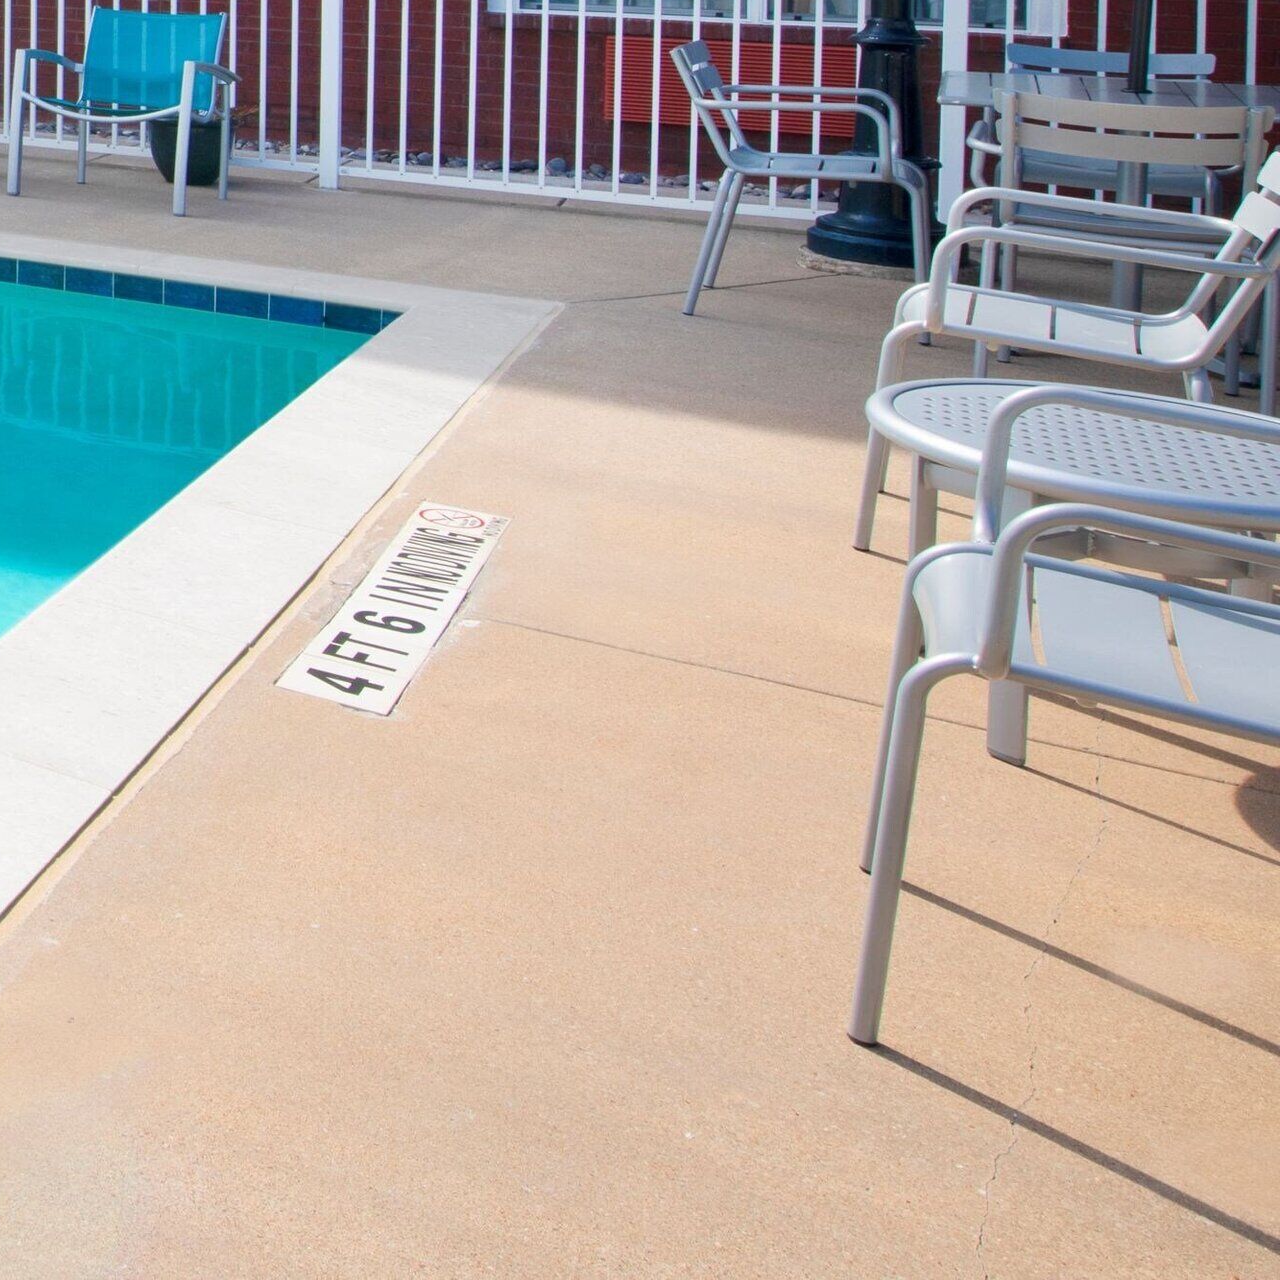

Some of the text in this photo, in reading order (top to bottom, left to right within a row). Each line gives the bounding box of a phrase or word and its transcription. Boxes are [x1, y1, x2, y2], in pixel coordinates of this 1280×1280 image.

[306, 527, 486, 696] 4 FT 6 IN NO DIVING
